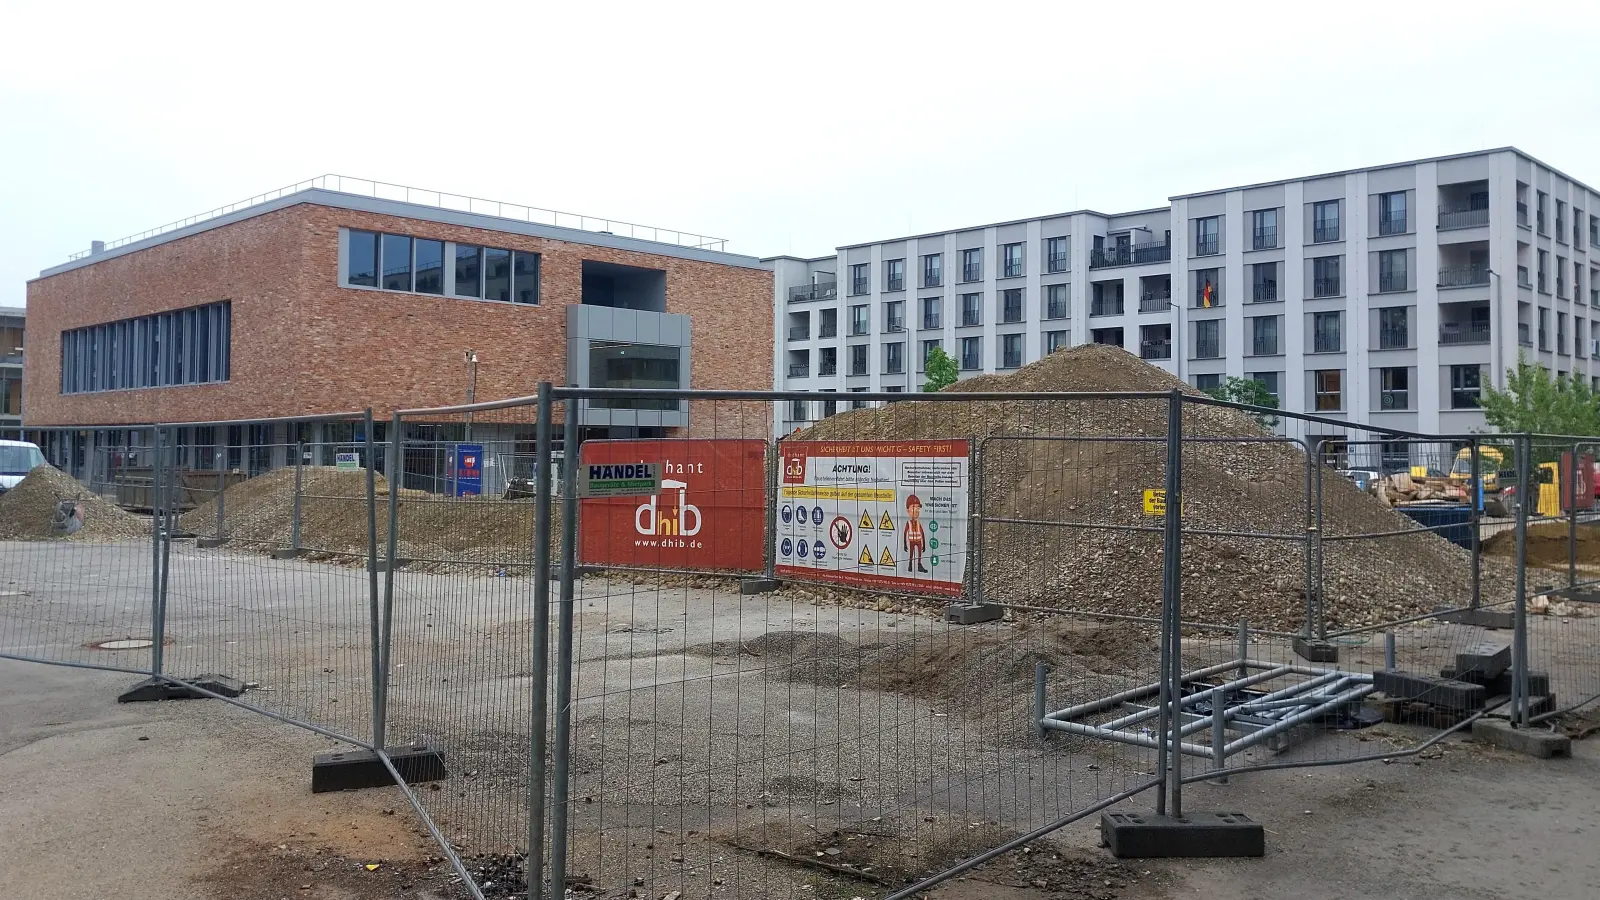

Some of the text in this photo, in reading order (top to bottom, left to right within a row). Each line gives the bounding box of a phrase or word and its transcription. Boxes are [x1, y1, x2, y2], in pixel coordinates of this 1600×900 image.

[860, 445, 874, 453] UNS
[875, 445, 902, 453] WICHTG
[908, 445, 931, 453] SAFETY
[589, 464, 652, 480] HÄNDEL
[832, 464, 871, 474] ACHTUNG!
[634, 539, 702, 549] www.dhib.de
